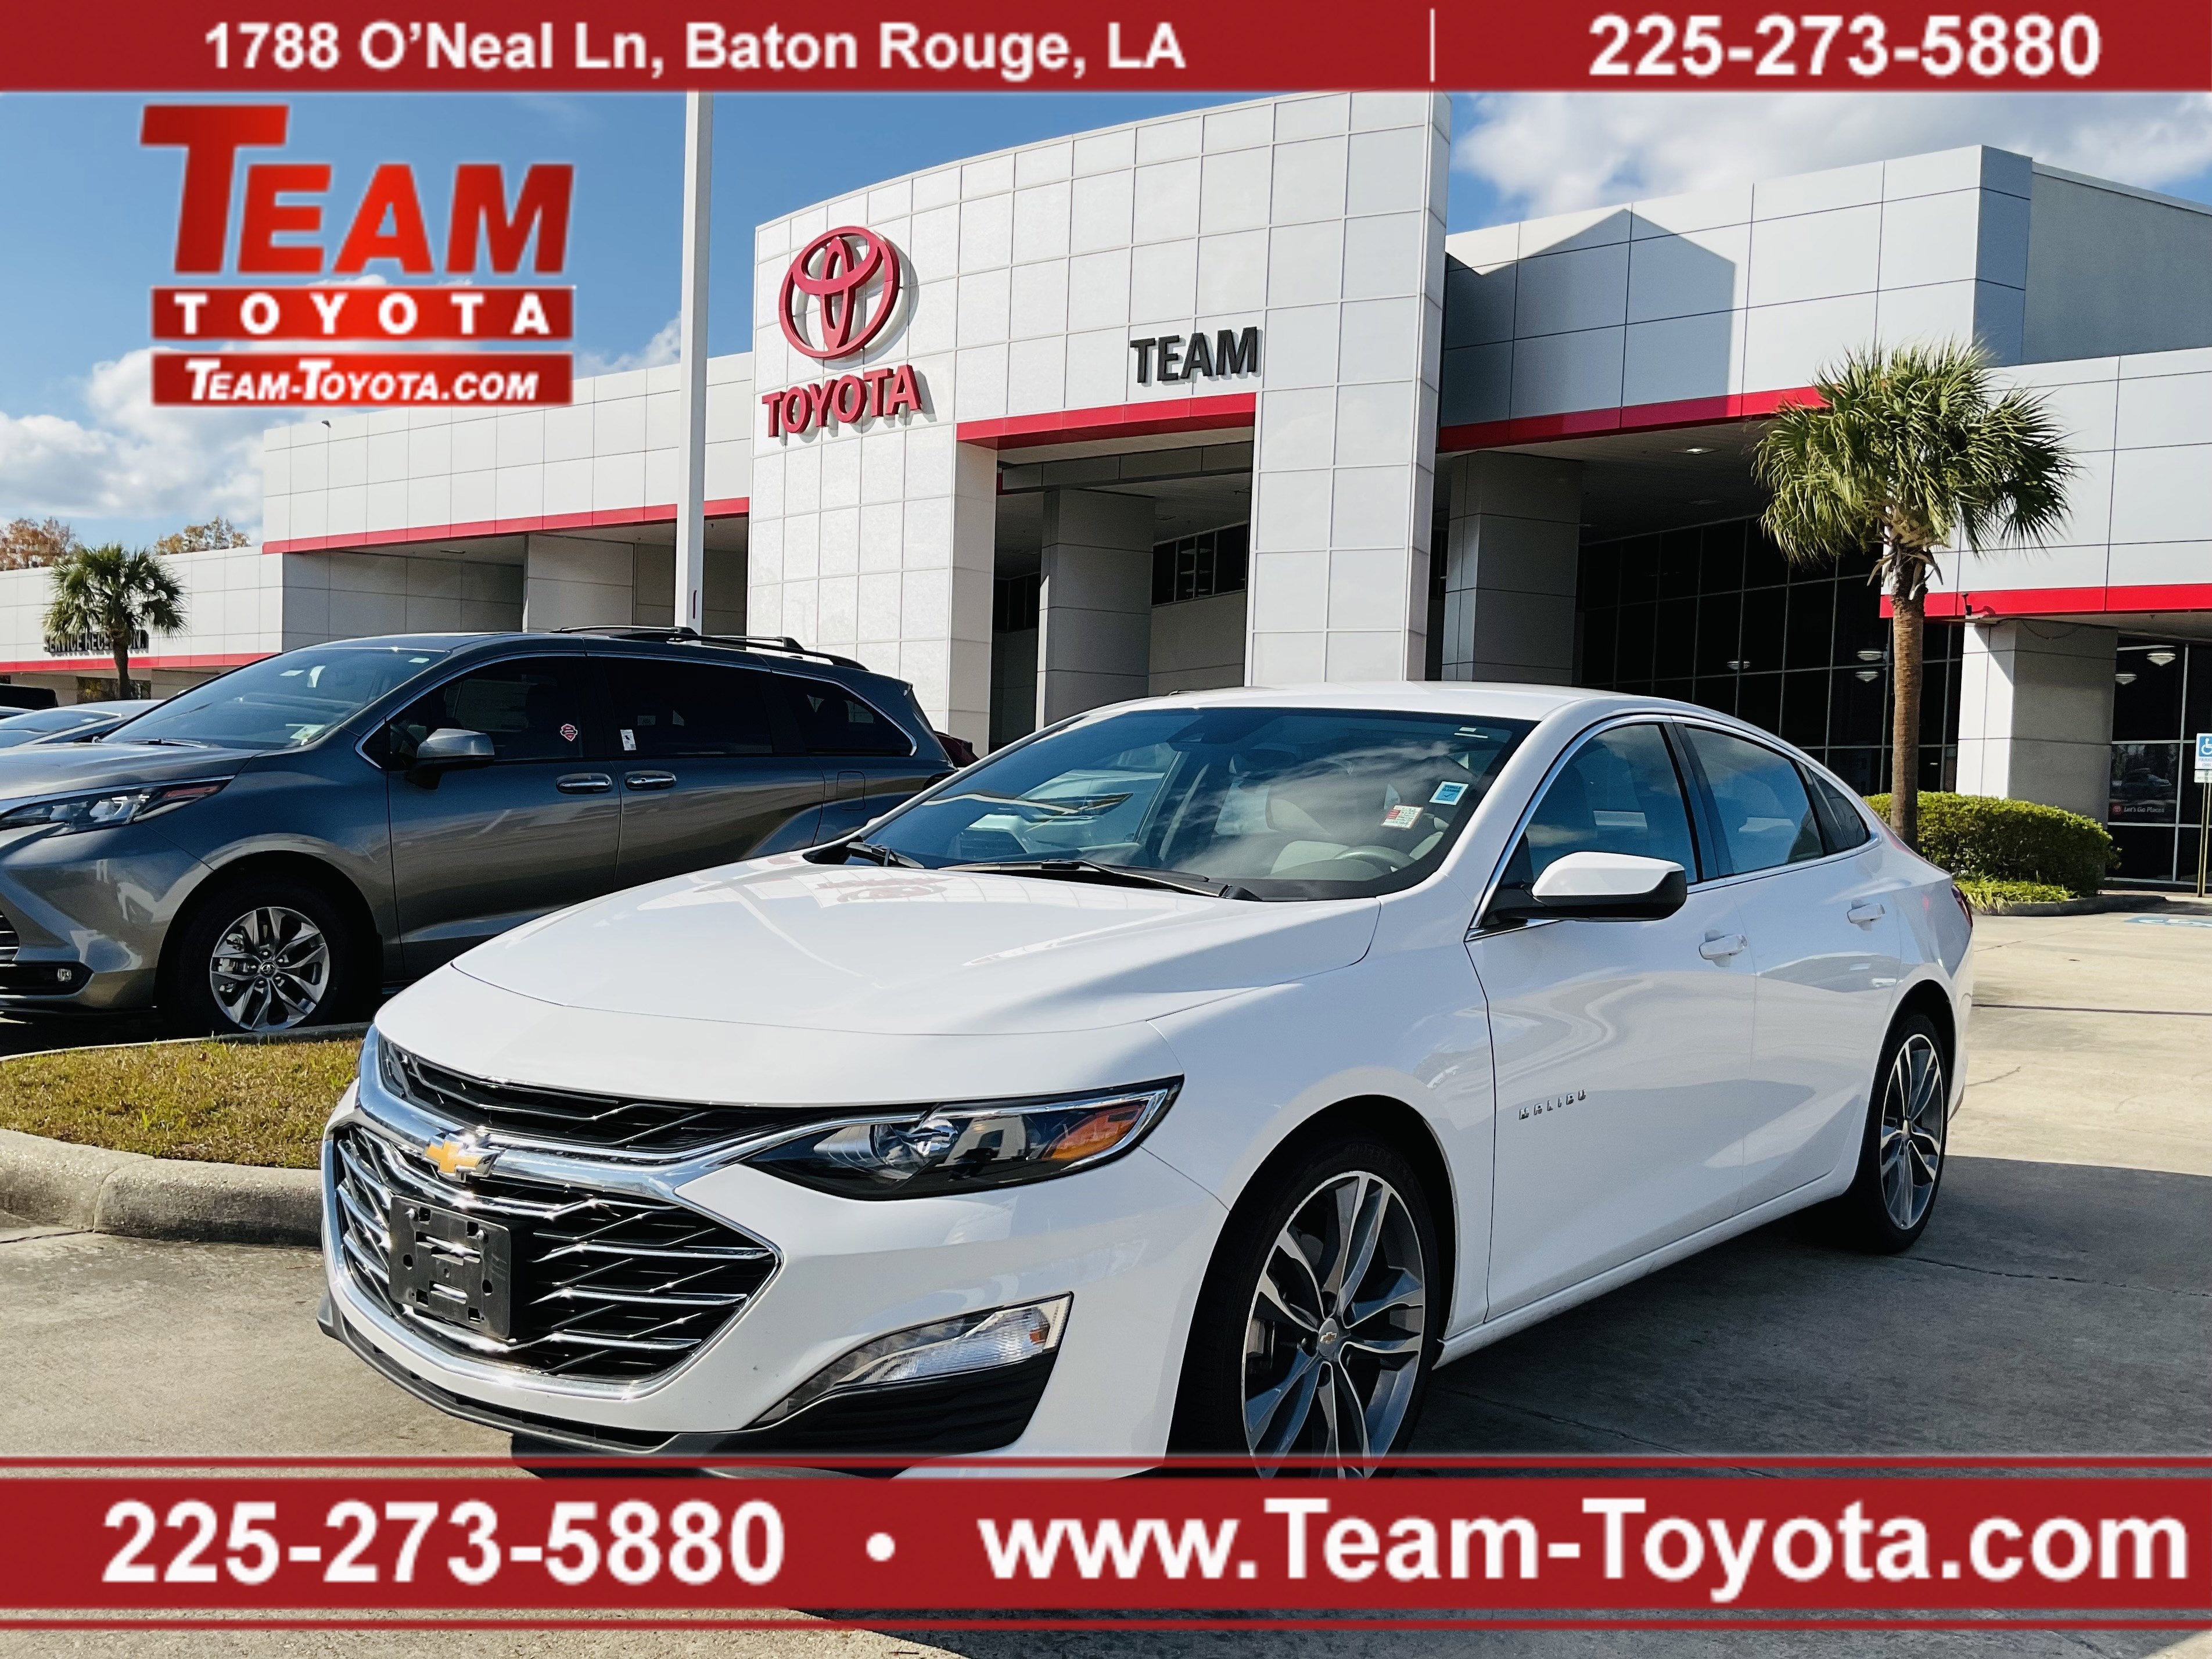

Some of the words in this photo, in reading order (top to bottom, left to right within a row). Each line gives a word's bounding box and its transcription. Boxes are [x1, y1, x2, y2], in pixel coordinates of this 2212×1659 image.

[1129, 326, 1258, 384] TEAM
[762, 364, 923, 438] TOYOTA
[1518, 1089, 1587, 1121] MALIBU
